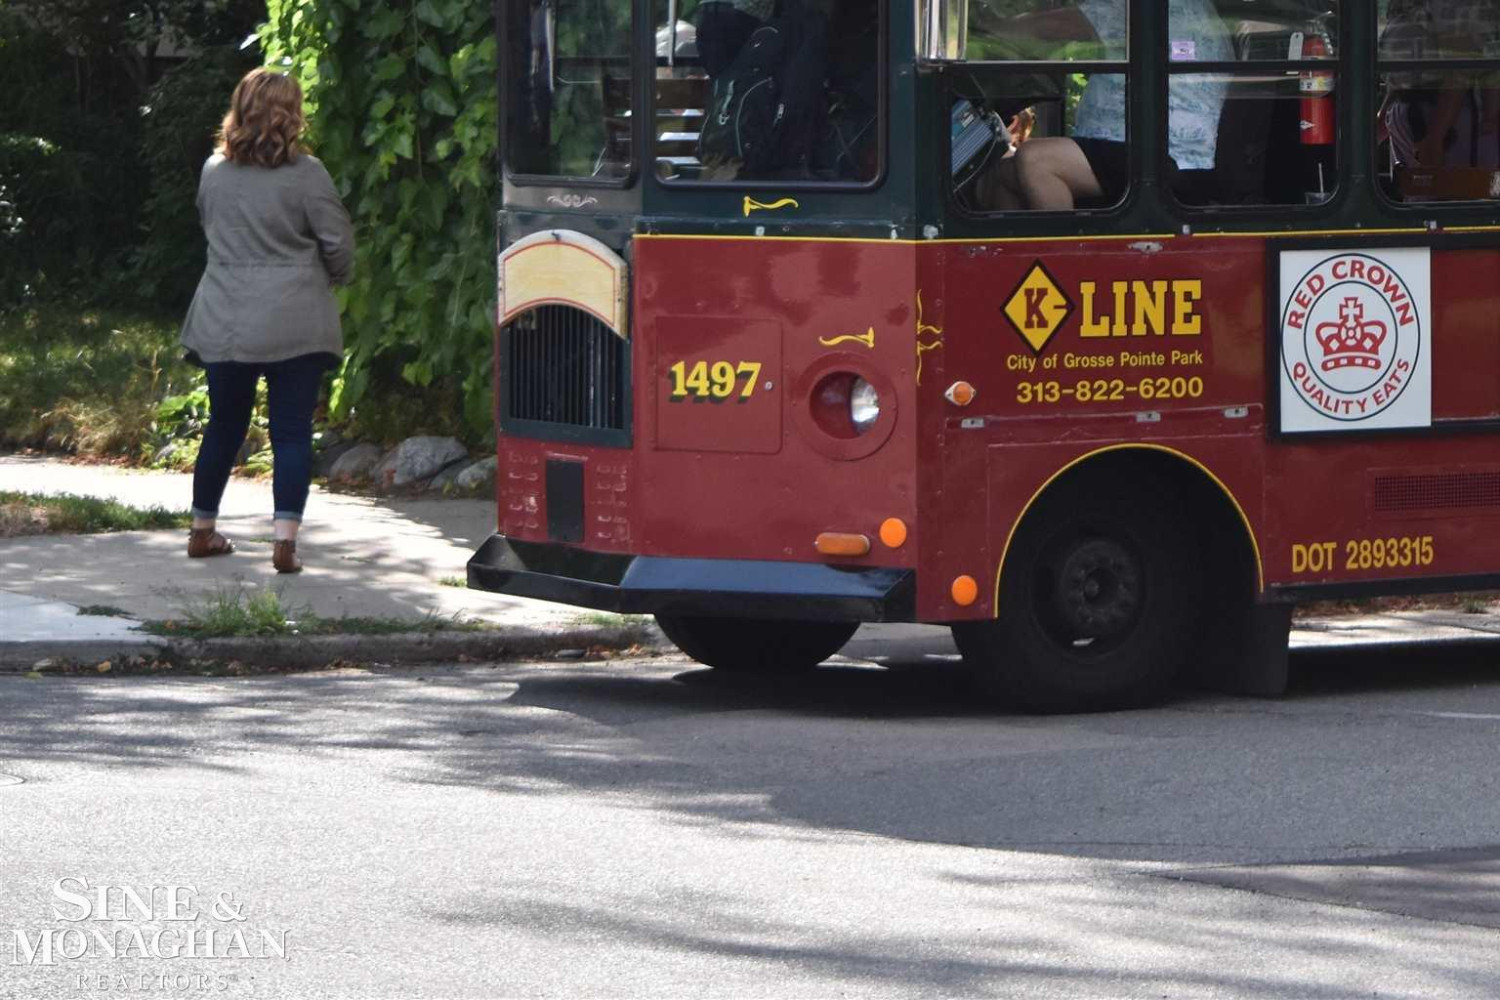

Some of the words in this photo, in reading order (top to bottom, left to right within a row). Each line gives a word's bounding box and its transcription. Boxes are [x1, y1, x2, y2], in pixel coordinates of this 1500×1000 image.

[1079, 279, 1202, 338] LINE
[1287, 273, 1326, 330] RED
[1331, 259, 1415, 327] CROWN
[669, 360, 762, 400] 1497
[1007, 354, 1037, 373] City
[1043, 353, 1058, 369] of
[1063, 352, 1115, 369] Grosse
[1120, 351, 1165, 367] Pointe
[1171, 350, 1203, 366] Park
[1016, 376, 1204, 404] 313-822-6200
[1293, 361, 1368, 414] QUALITY
[1371, 358, 1410, 406] EATS
[1292, 542, 1337, 573] DOT
[1345, 536, 1434, 570] 2893315
